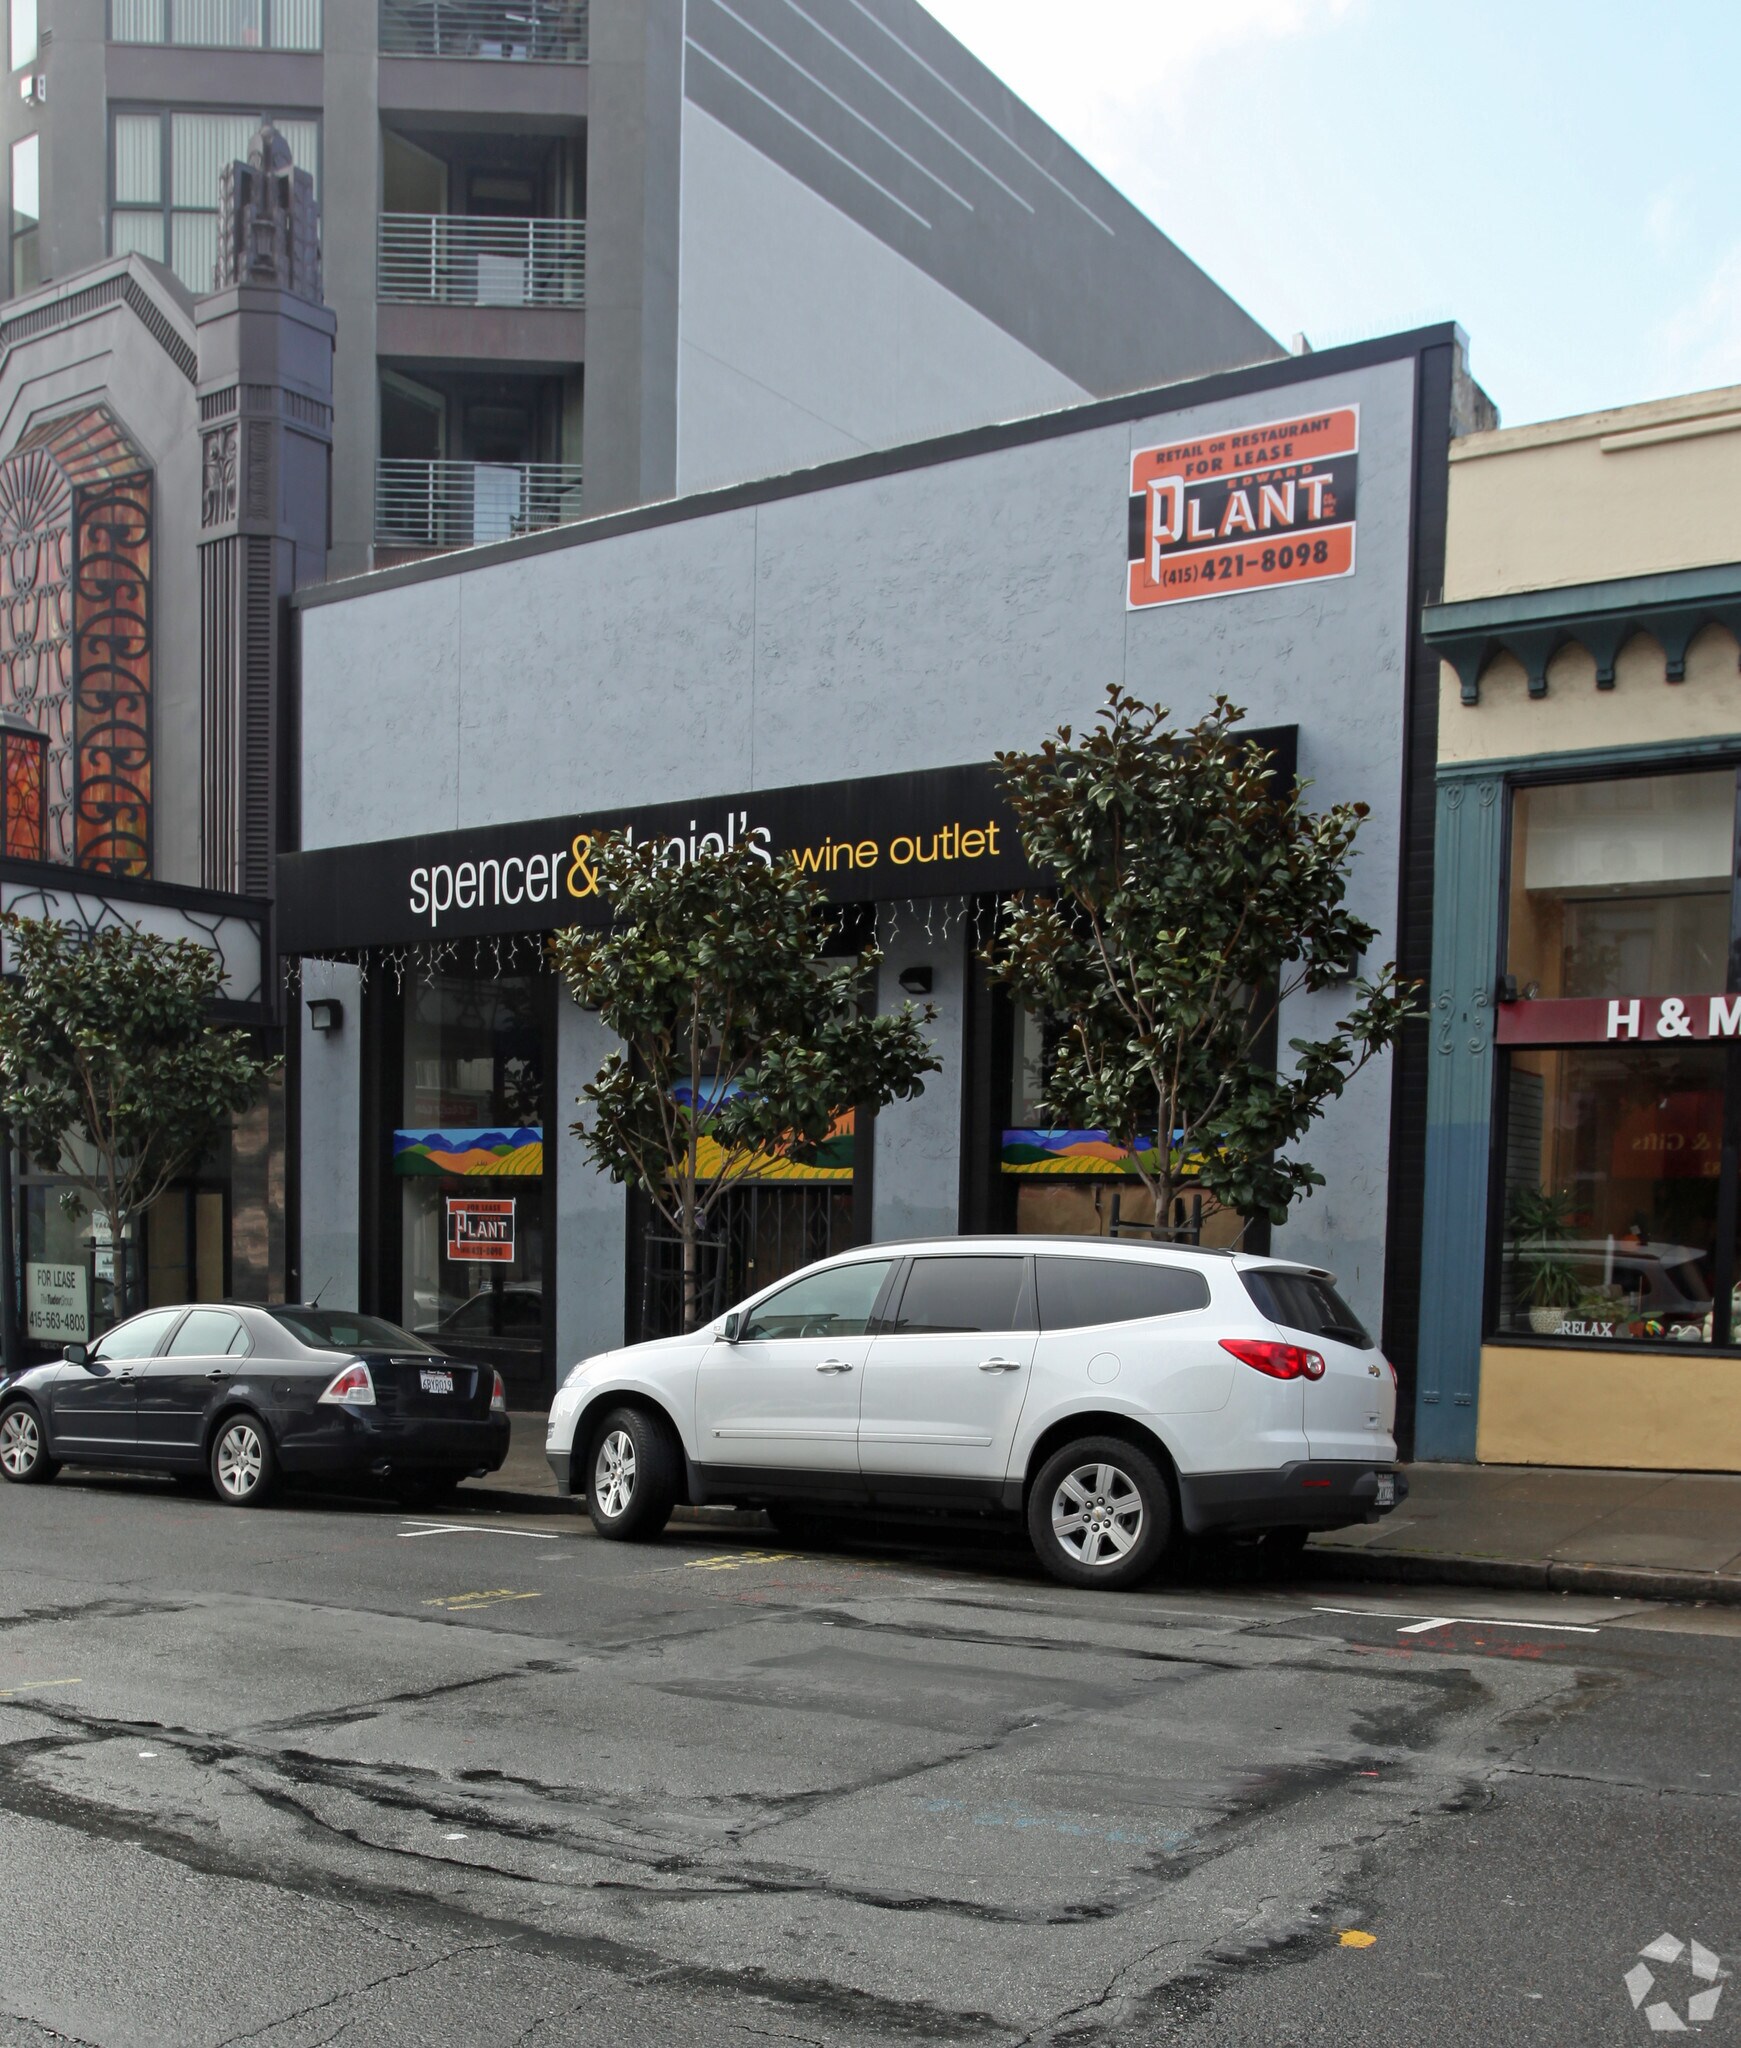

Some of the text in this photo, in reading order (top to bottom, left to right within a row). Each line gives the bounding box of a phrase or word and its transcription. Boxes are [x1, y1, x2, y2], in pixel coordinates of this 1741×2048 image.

[1156, 418, 1331, 464] RETAIL OR RESTAURANT
[1185, 443, 1293, 477] FOR LEASE
[1227, 464, 1313, 489] EDWARD
[1144, 473, 1333, 588] PLANT
[1162, 540, 1328, 587] (415) 421-8098
[792, 820, 1000, 873] wine outlet
[410, 850, 566, 927] spencer
[1607, 1000, 1641, 1038] H
[1656, 998, 1693, 1037] &
[455, 1210, 507, 1249] PLANT
[37, 1269, 76, 1289] FOR LEASE
[29, 1311, 86, 1332] 415-563-4803
[1560, 1320, 1614, 1338] RELAX
